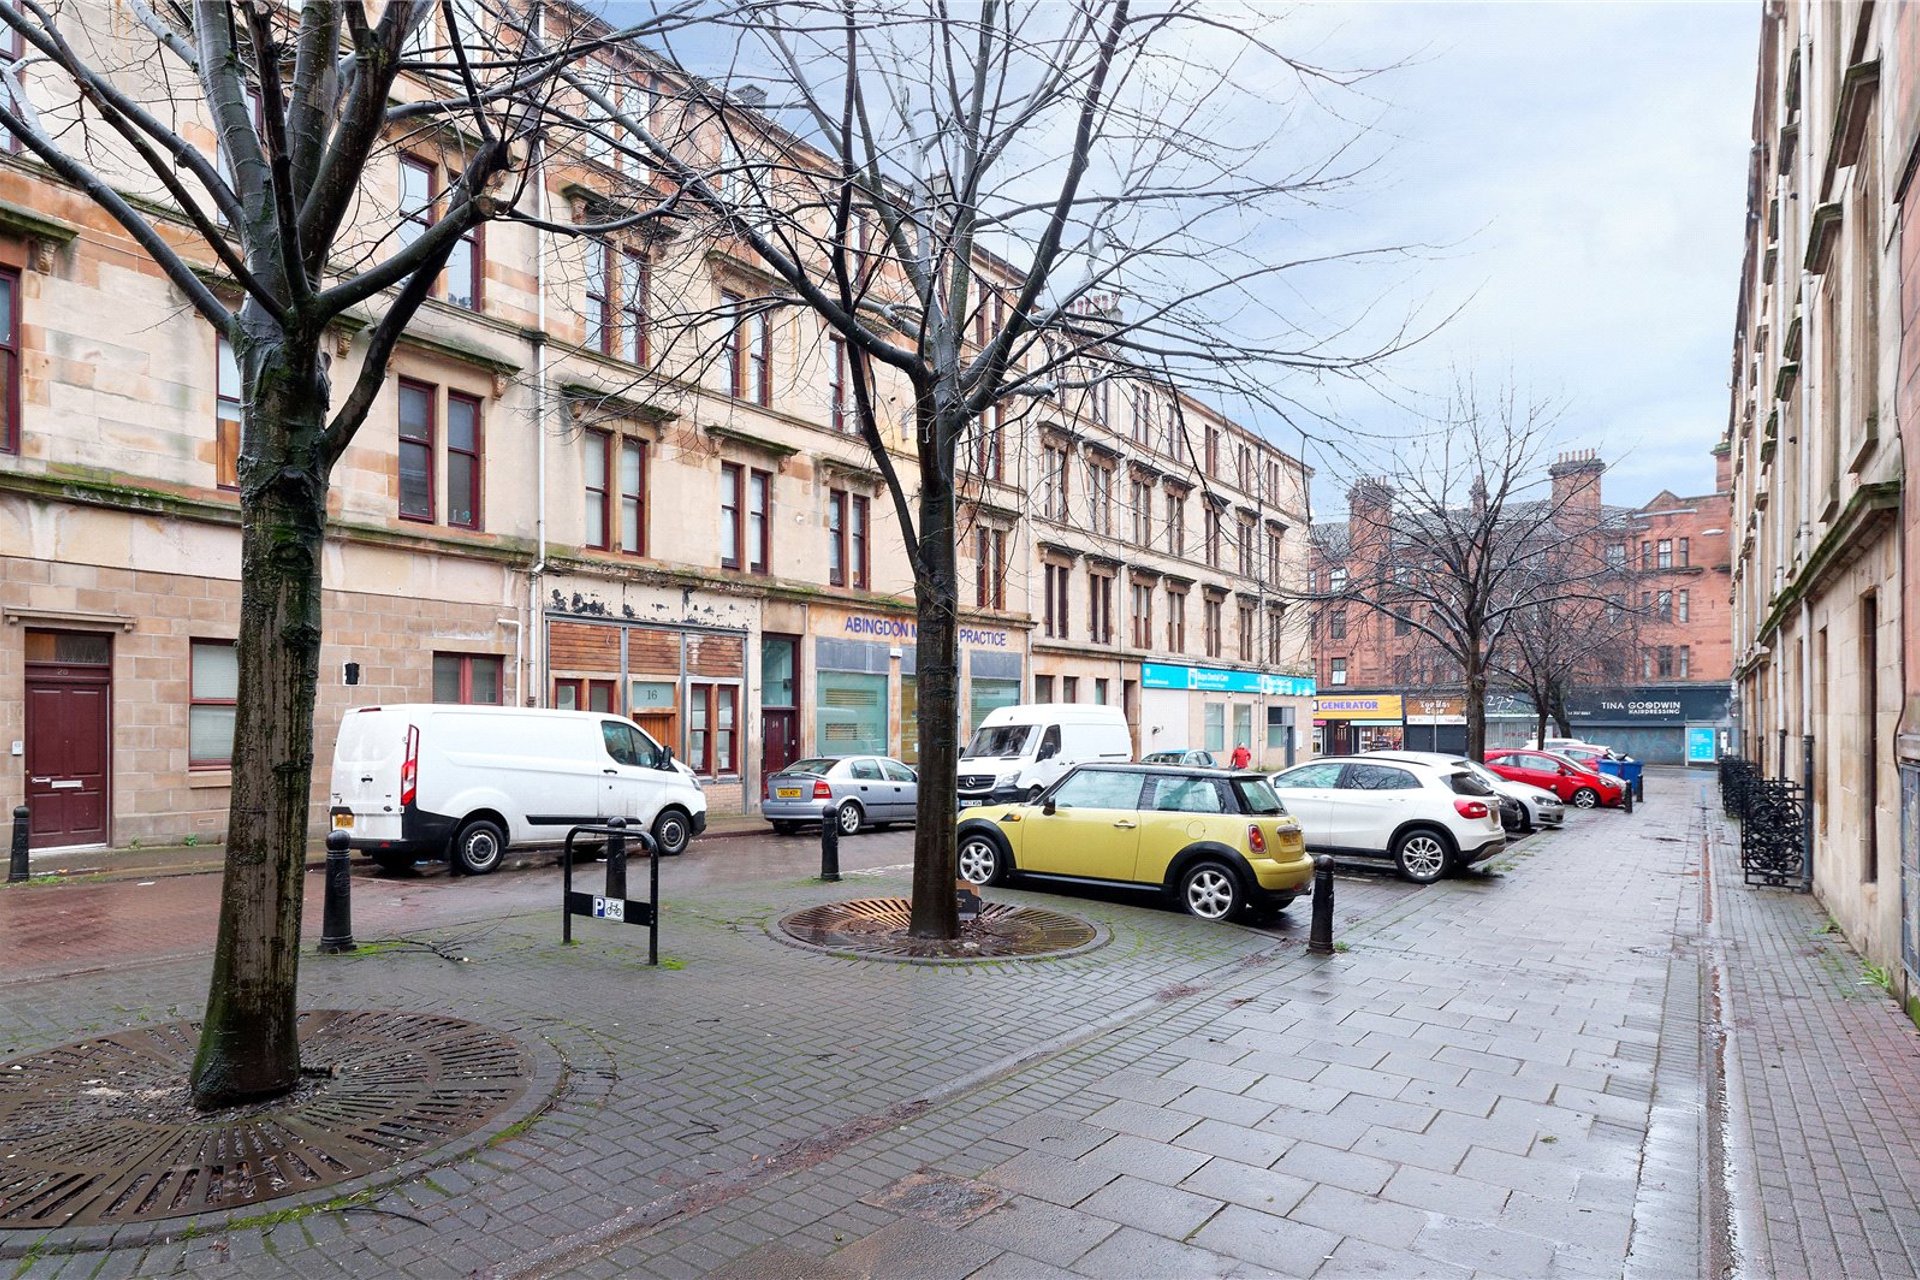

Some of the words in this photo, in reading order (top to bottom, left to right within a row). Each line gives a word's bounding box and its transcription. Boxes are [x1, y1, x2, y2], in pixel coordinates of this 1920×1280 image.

[844, 616, 909, 638] ABINGDON
[959, 628, 1007, 648] PRACTICE
[647, 689, 658, 700] 16
[1321, 701, 1378, 710] GENERATOR
[1486, 695, 1514, 710] 279
[1601, 702, 1624, 710] TINA
[1628, 701, 1681, 710] GOODWIN
[595, 898, 605, 915] P
